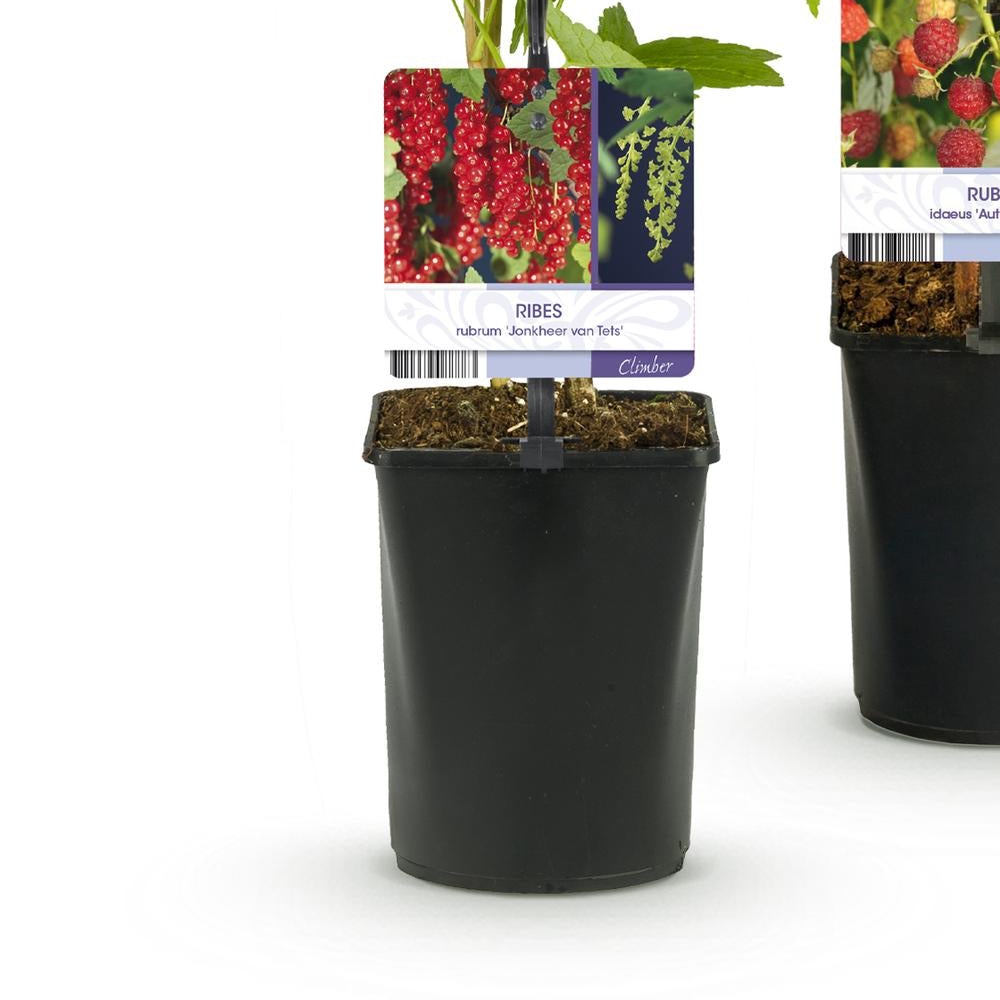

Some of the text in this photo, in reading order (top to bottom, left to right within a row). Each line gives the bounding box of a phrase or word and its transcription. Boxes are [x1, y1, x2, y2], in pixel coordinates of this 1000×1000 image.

[929, 208, 973, 220] idaeus
[515, 303, 563, 319] RIBES
[456, 325, 623, 337] rubrum 'Jonkheer van Tets'
[618, 355, 674, 376] Climber
